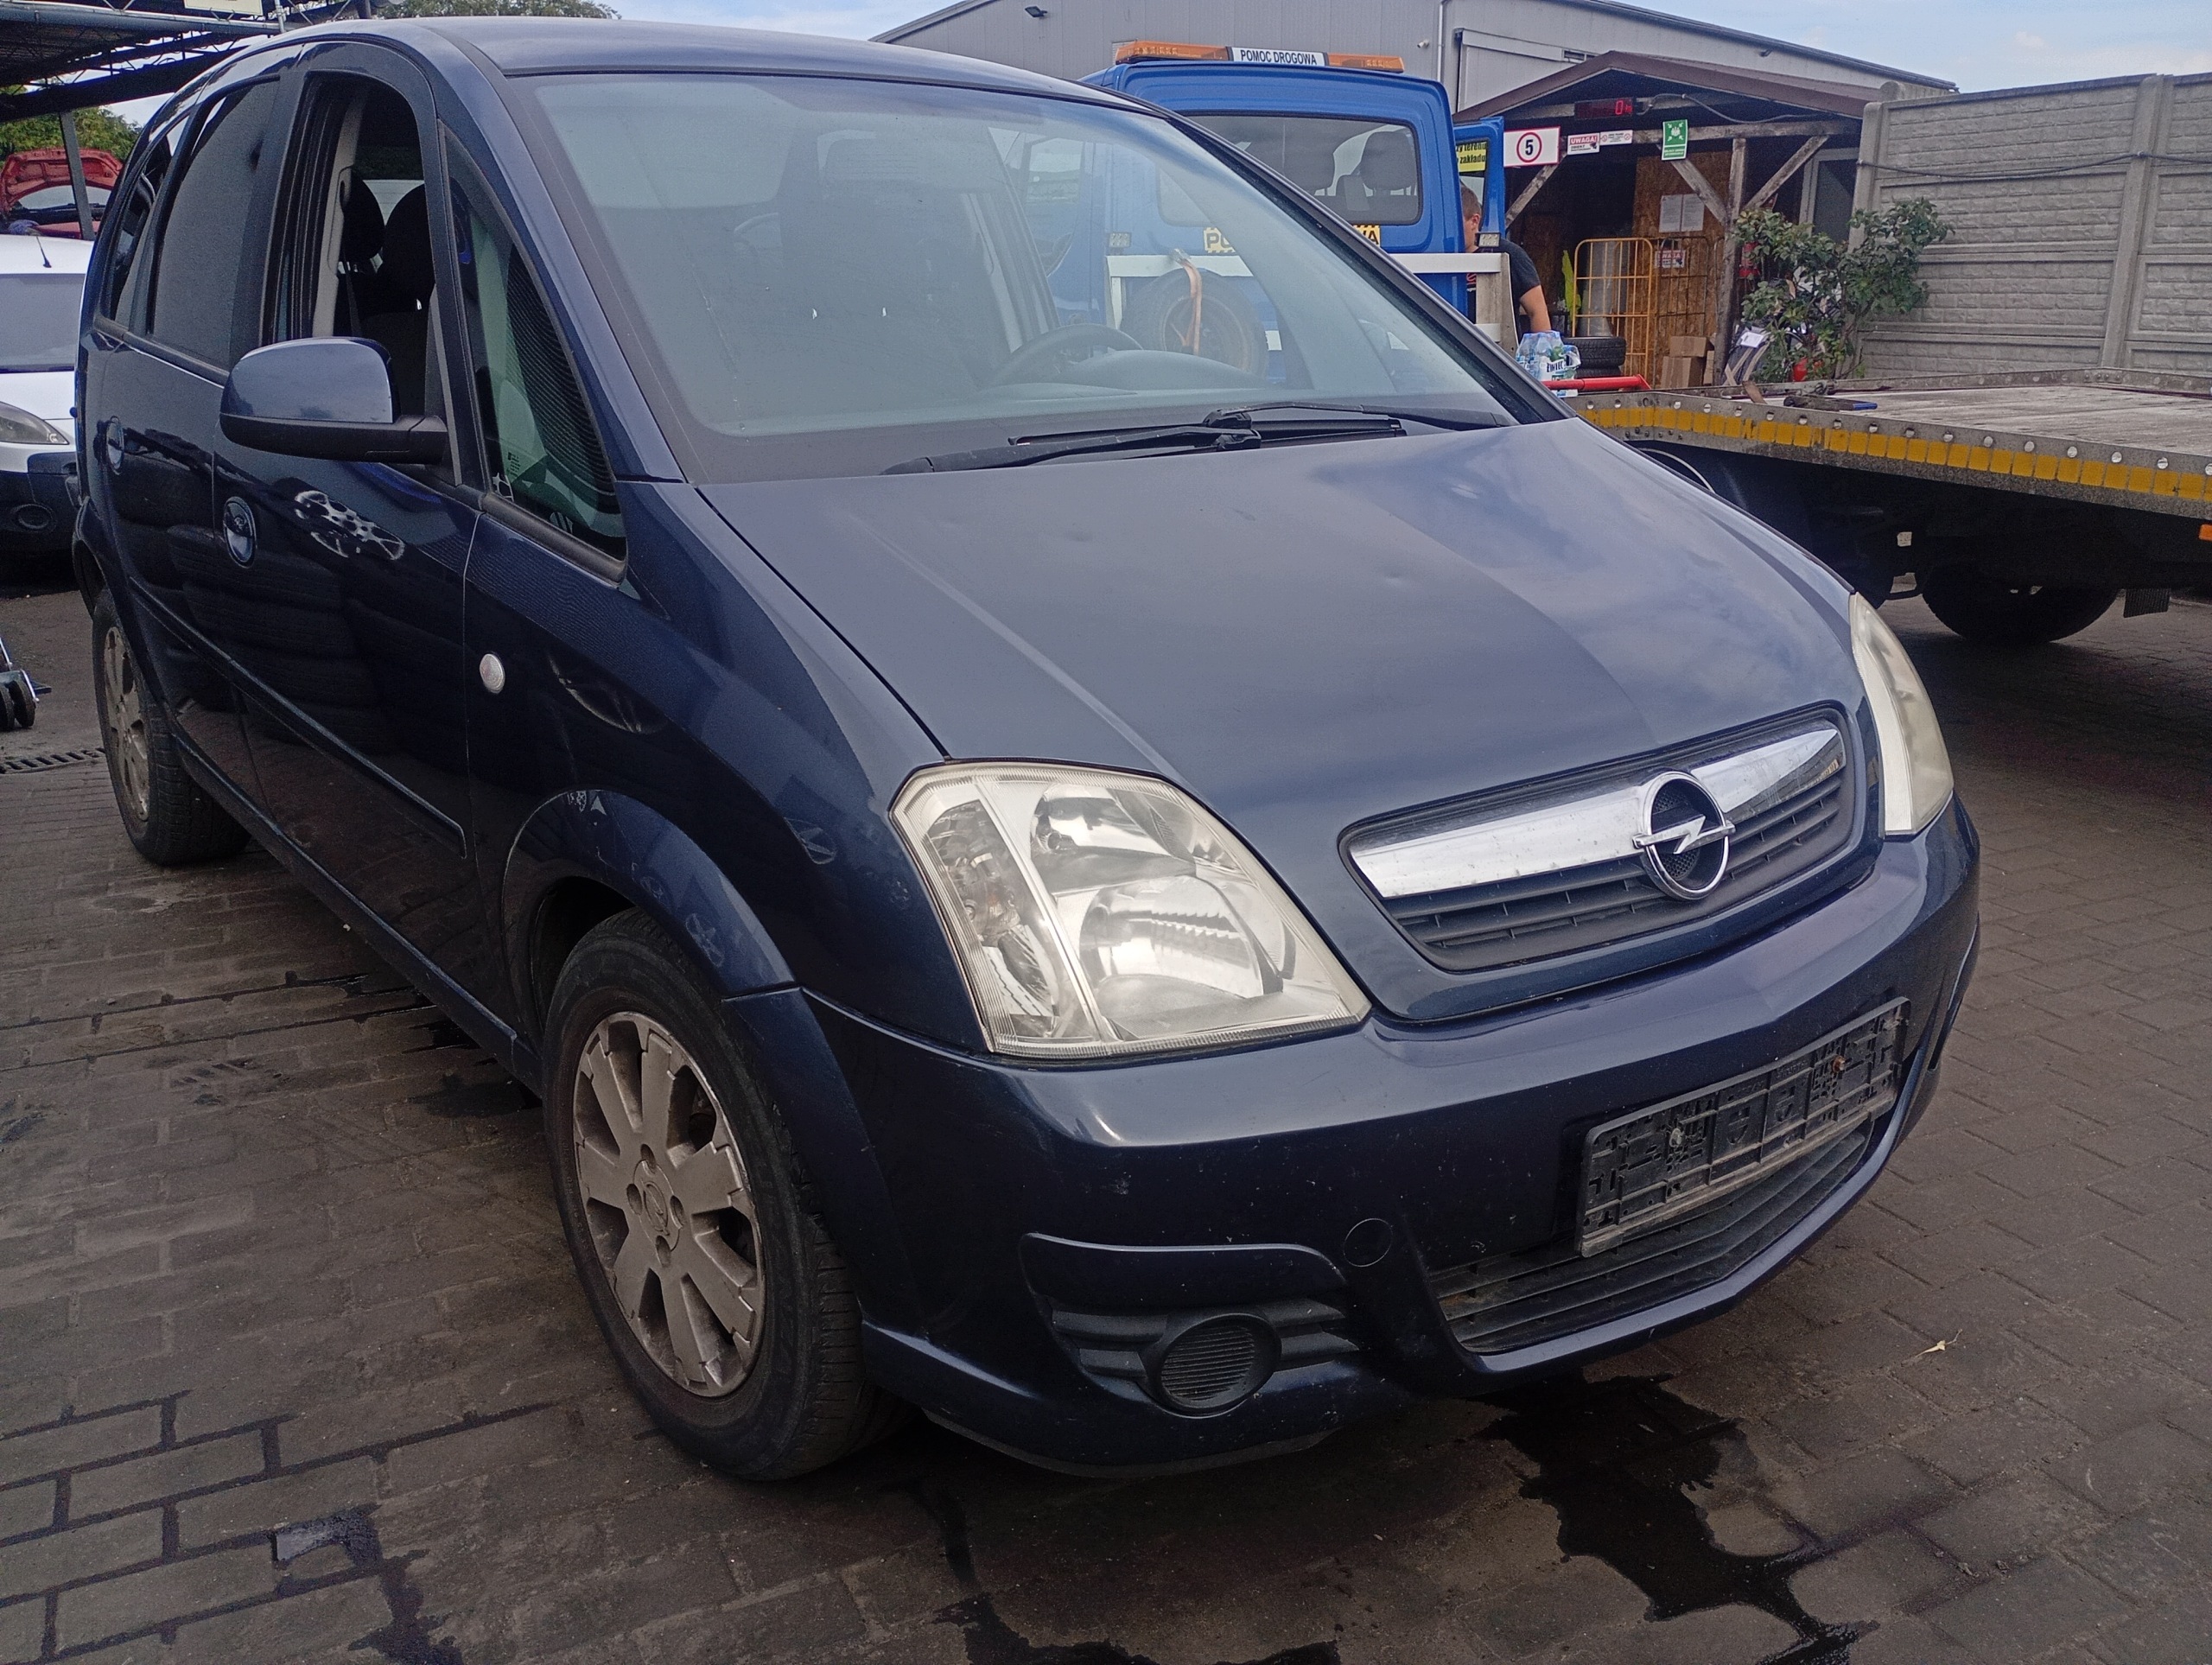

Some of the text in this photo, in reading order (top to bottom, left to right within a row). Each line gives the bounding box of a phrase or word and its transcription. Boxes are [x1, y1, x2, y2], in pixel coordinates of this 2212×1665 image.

[1240, 49, 1318, 66] POMOC DROGOWA
[1525, 139, 1534, 156] 5
[1570, 136, 1597, 145] UWAGA!
